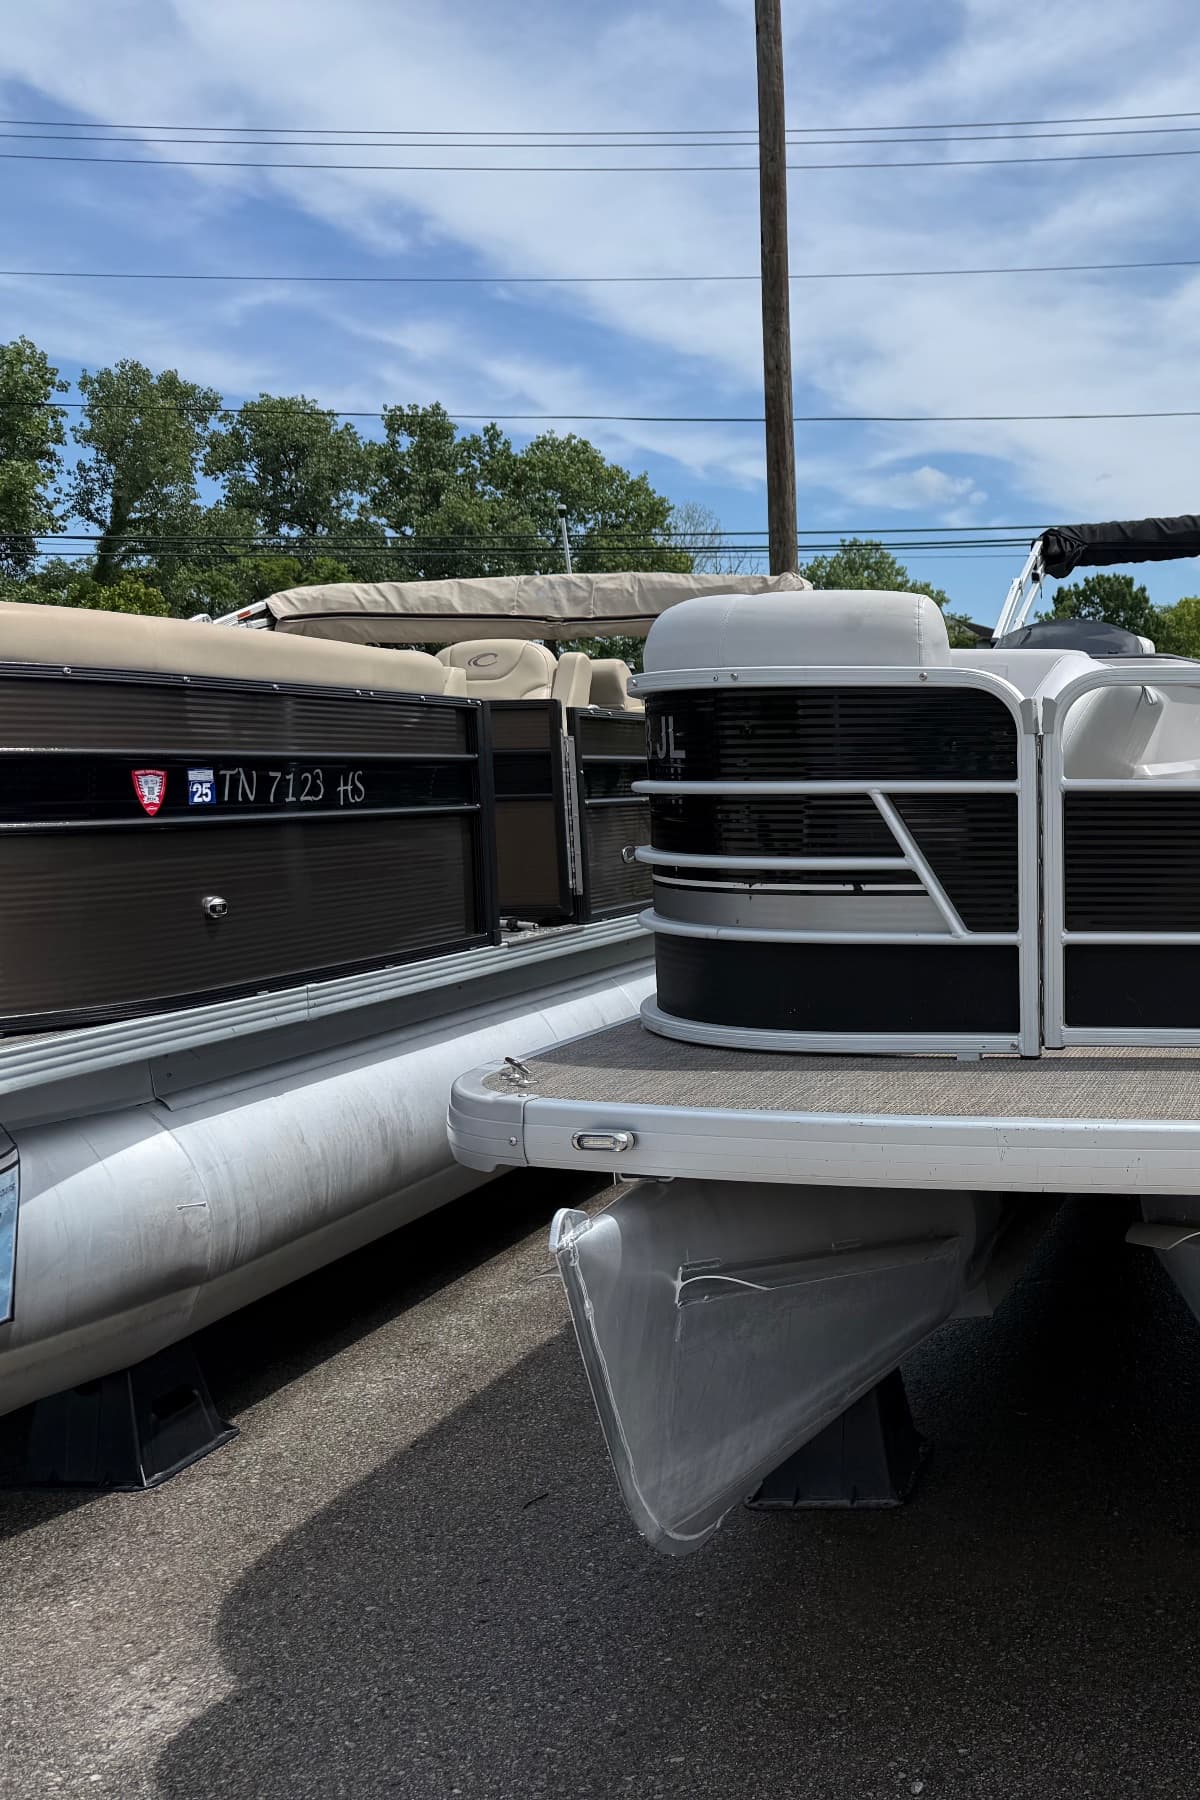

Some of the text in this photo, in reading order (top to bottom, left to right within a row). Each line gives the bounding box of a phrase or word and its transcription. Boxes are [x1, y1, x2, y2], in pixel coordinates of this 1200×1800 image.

[192, 783, 212, 803] 25
[219, 767, 365, 806] TN 7123 HS
